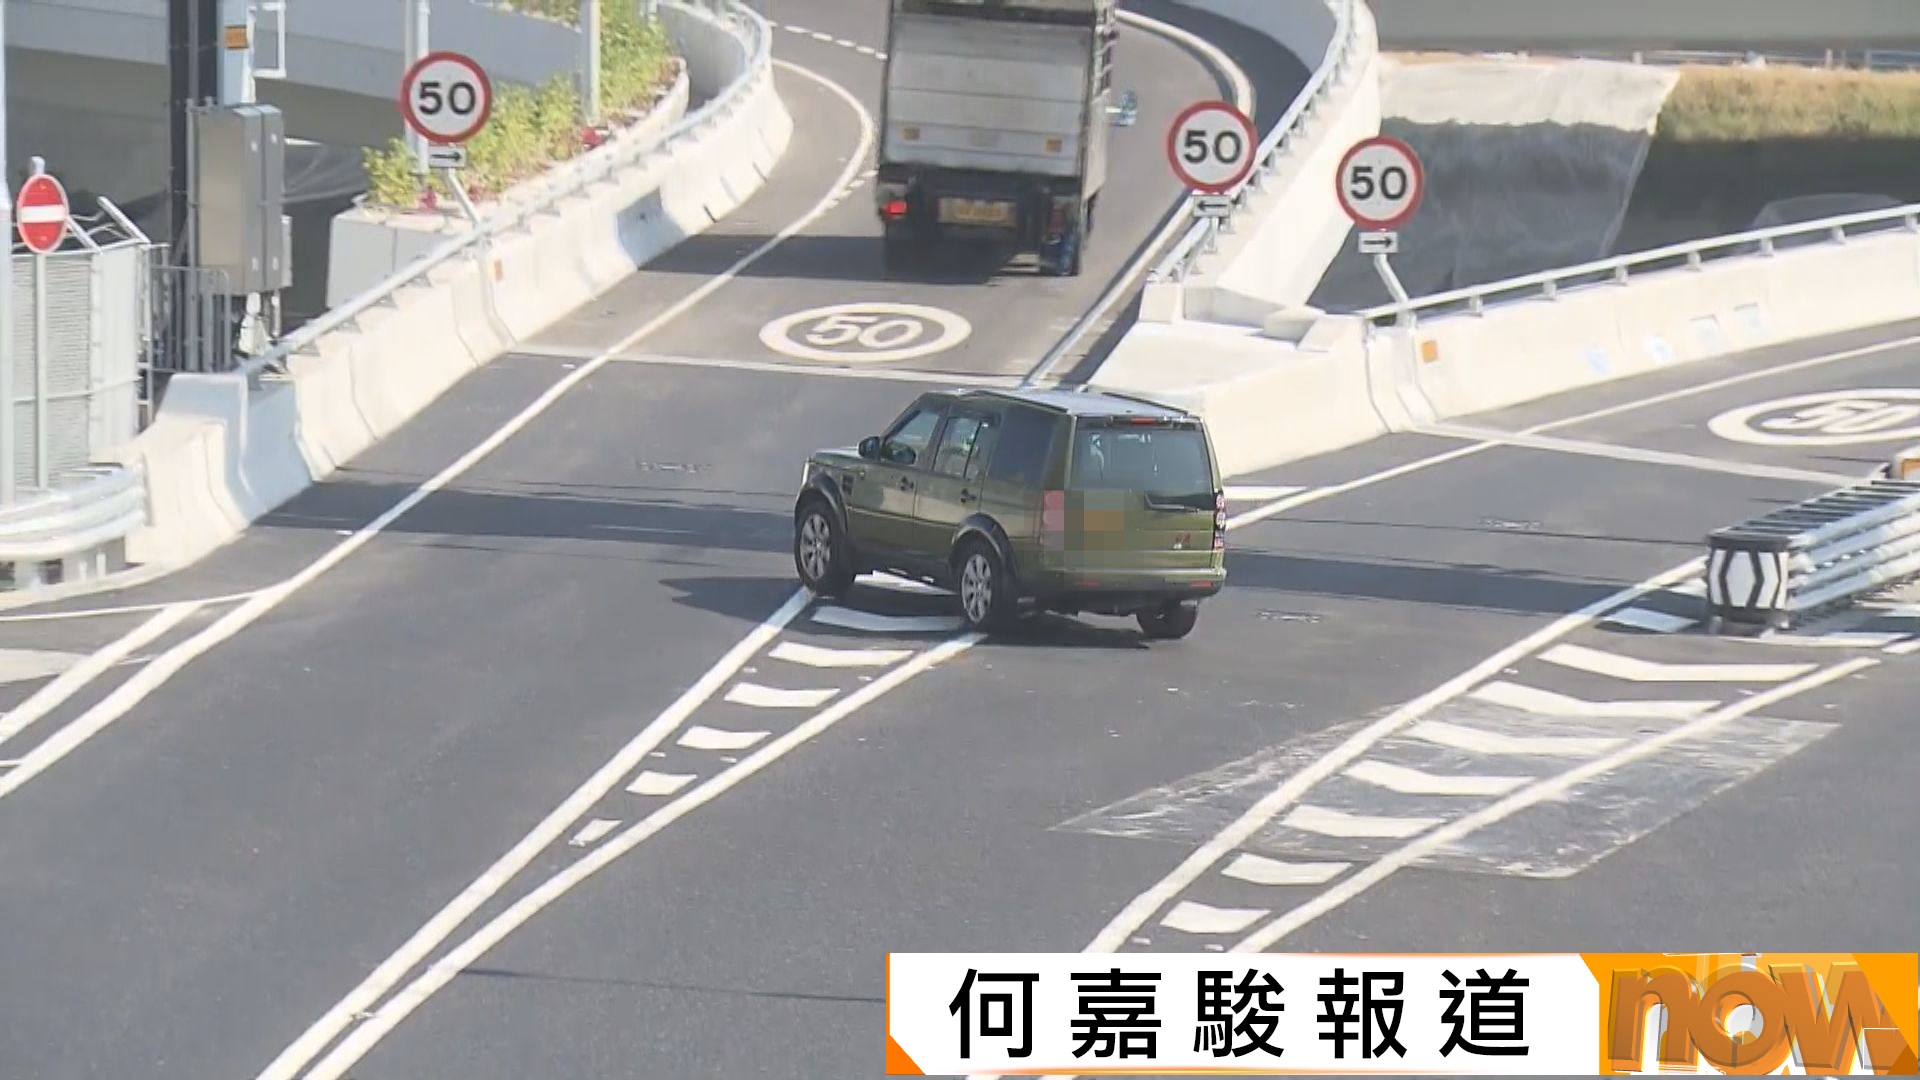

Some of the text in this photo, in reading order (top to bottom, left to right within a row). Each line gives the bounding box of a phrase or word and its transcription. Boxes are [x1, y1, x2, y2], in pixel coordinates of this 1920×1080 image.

[418, 81, 476, 115] 50
[1183, 130, 1242, 164] 50
[1349, 165, 1408, 201] 50
[806, 316, 923, 348] 50
[1761, 400, 1920, 433] 50
